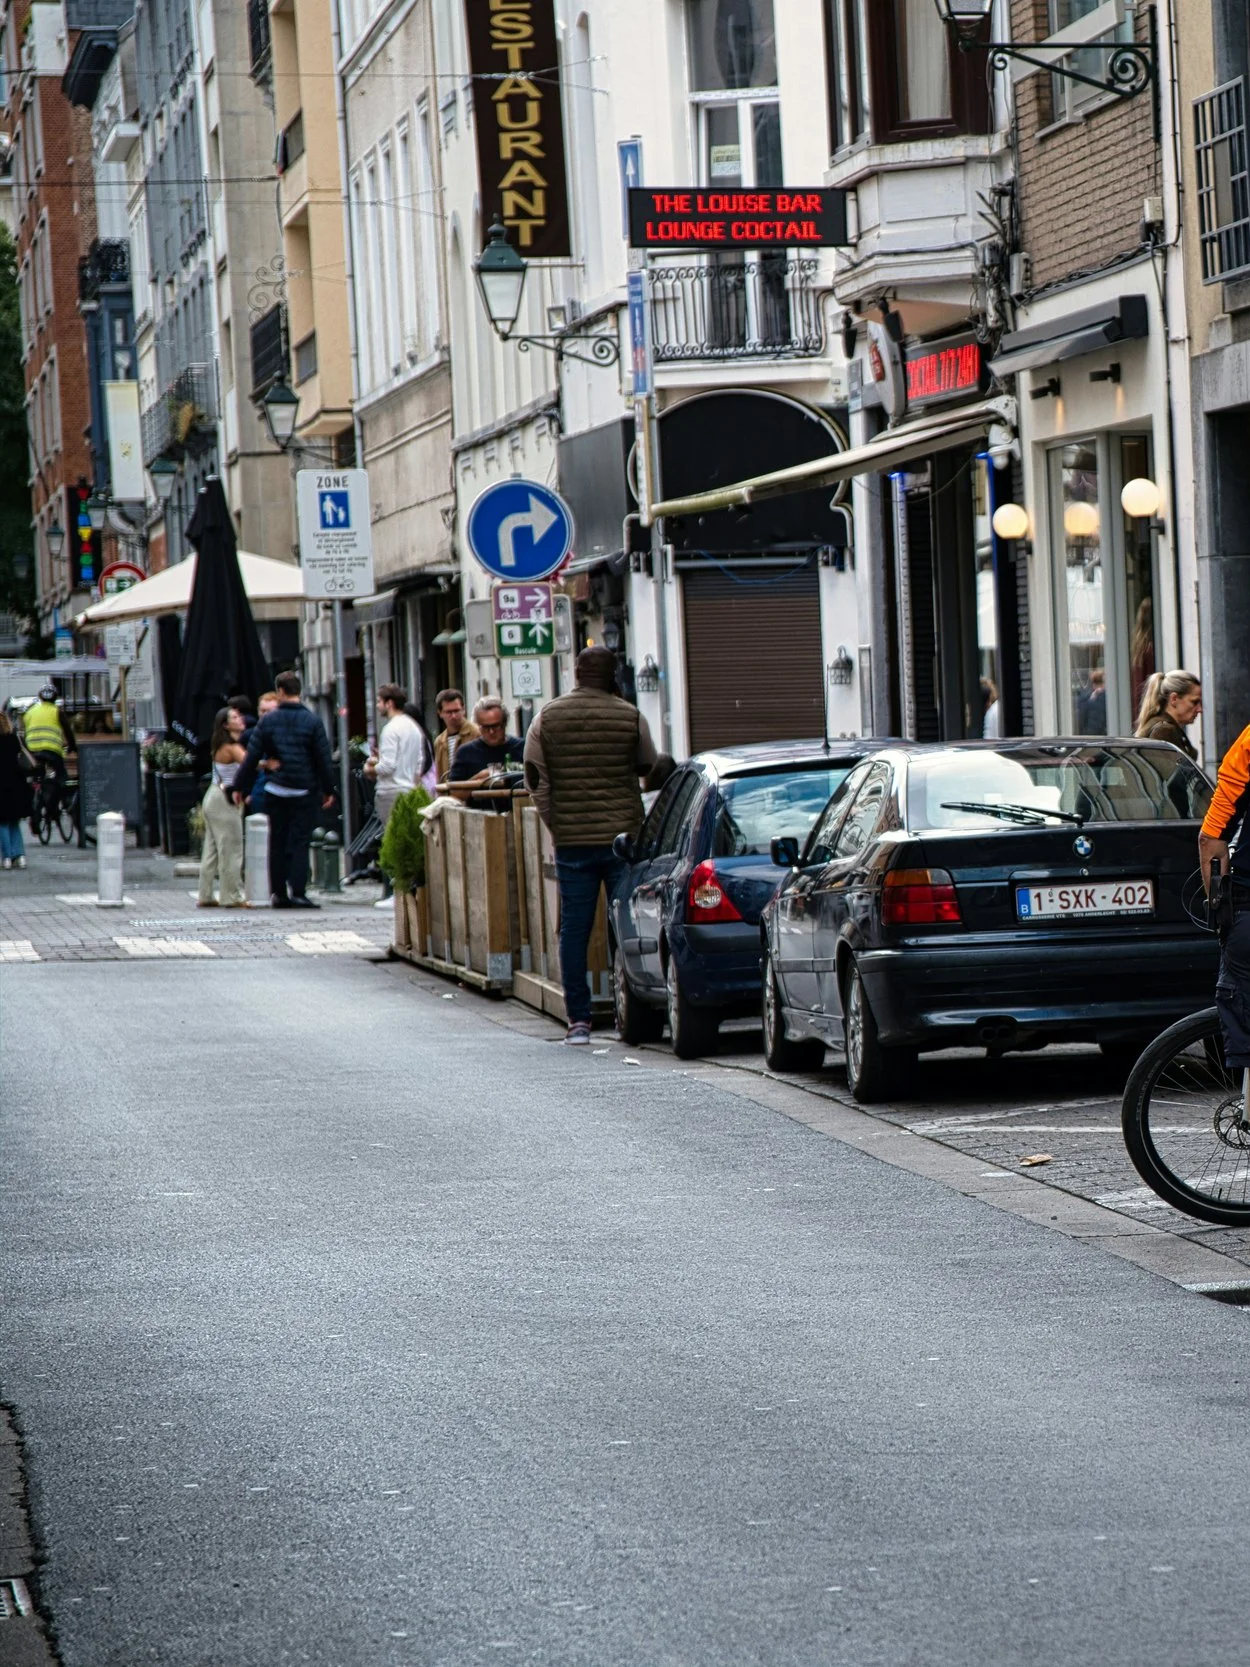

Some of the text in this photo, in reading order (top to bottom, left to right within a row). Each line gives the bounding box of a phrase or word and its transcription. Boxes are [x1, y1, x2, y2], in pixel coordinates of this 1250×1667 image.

[652, 194, 823, 214] THE LOUISE BAR
[646, 221, 823, 241] LOUNGE COCTAIL
[316, 475, 349, 489] ZONE
[503, 594, 515, 604] 9a
[508, 630, 514, 639] 6
[1021, 904, 1029, 914] B
